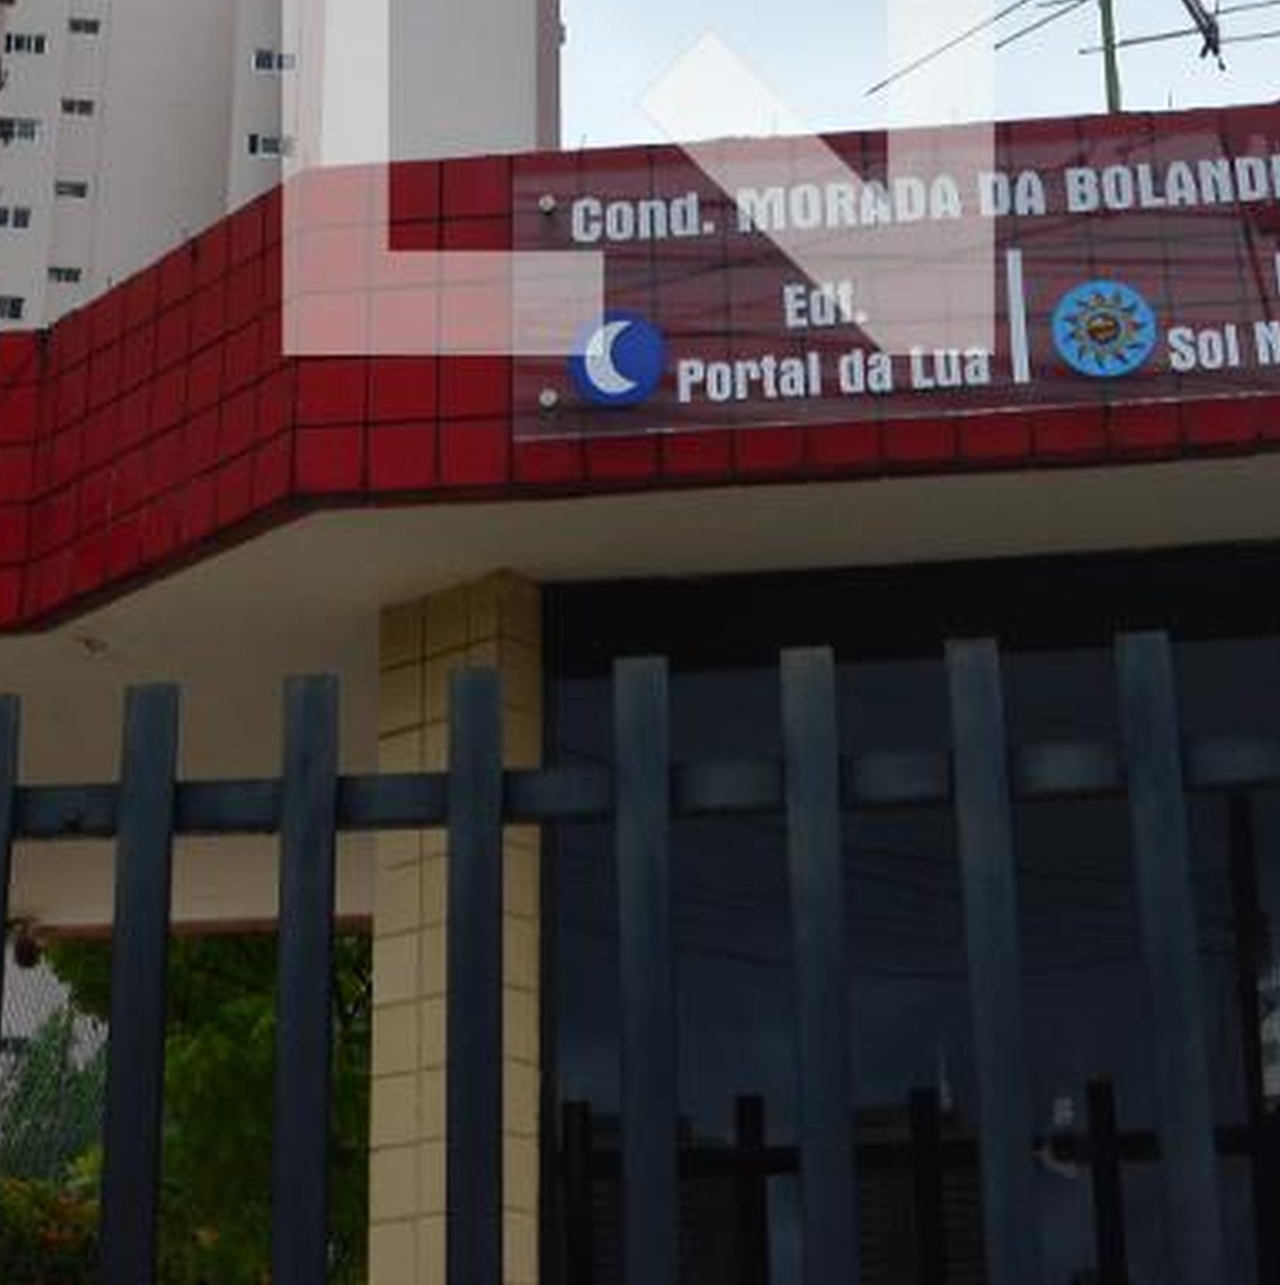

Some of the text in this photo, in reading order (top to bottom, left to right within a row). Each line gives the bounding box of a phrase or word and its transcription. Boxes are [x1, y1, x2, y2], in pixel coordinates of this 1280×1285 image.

[572, 192, 715, 242] Cond.
[736, 176, 962, 232] MORADA
[978, 171, 1046, 216] DA
[677, 344, 991, 403] Portal da Lua
[1168, 324, 1241, 372] Sol
